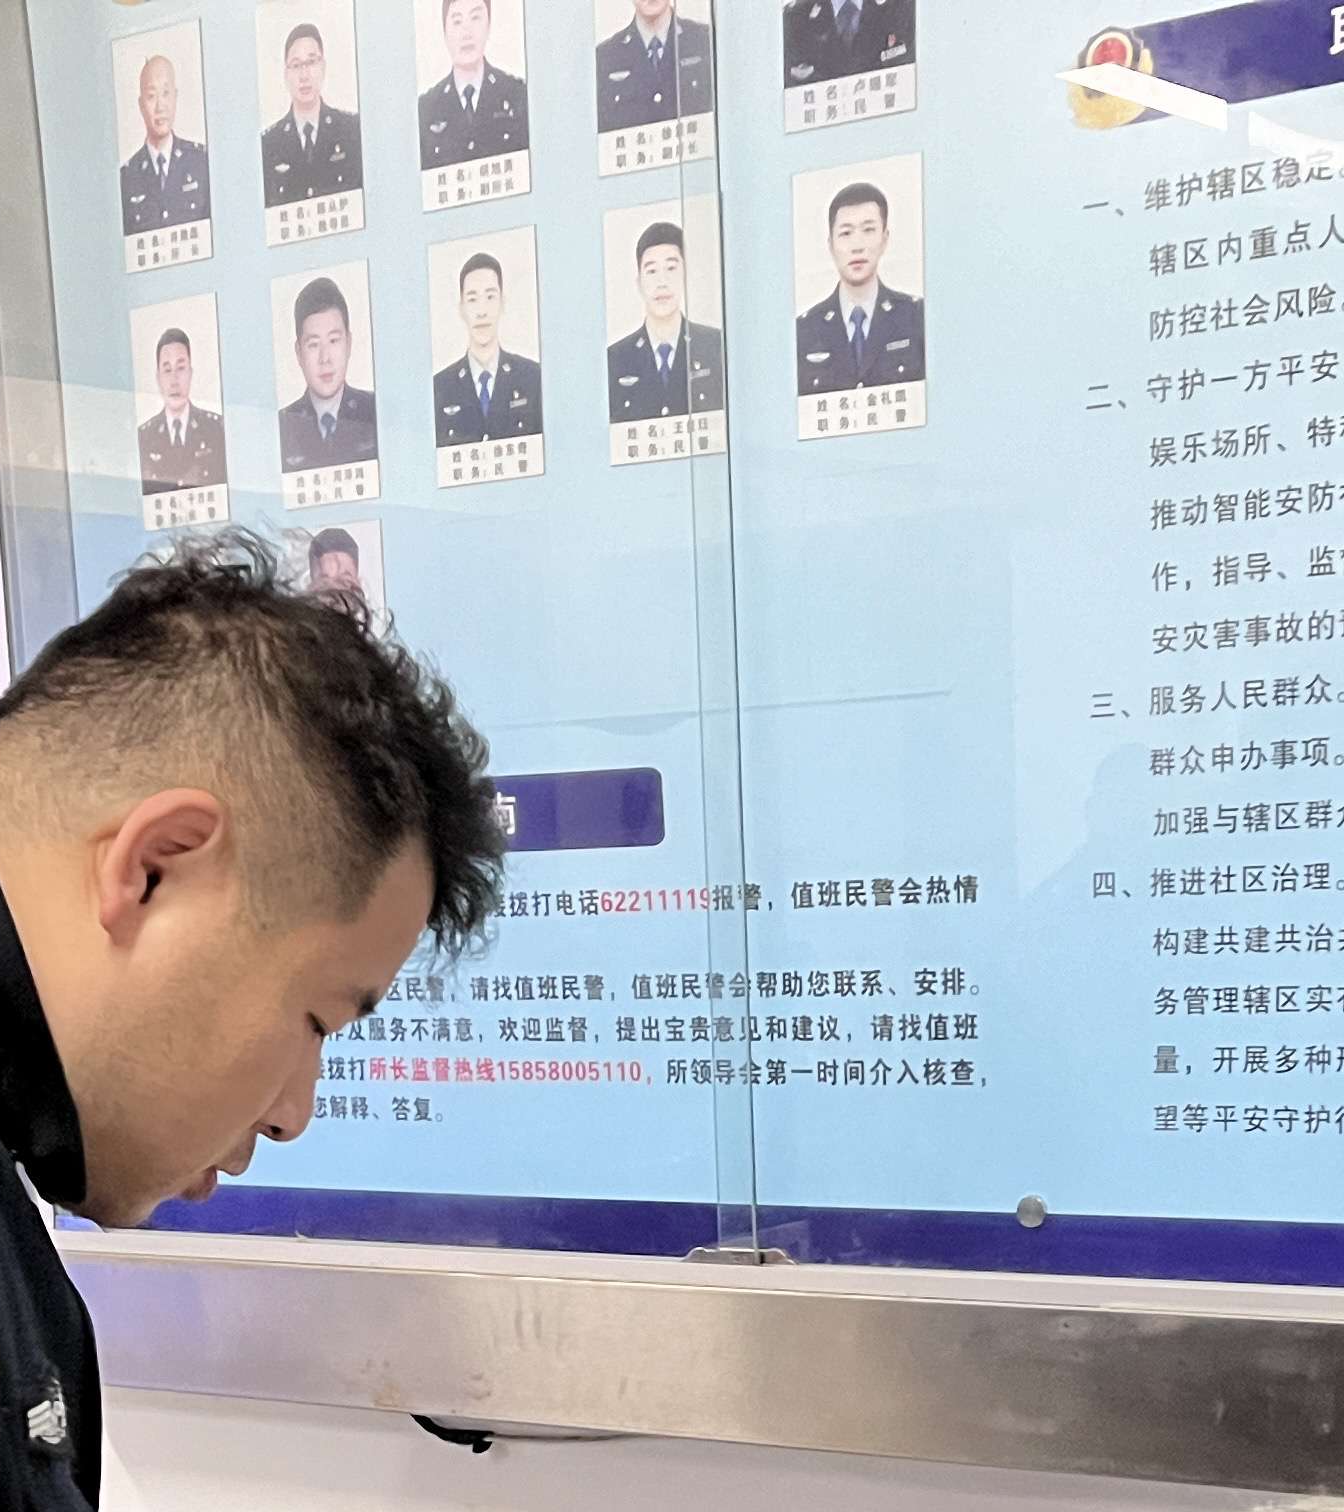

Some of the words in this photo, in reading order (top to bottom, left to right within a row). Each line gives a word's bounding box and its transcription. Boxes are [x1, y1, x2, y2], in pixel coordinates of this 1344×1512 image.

[320, 1057, 989, 1088] 拨打所长监督热线15858005110，所领导会第一时间介入核查，
